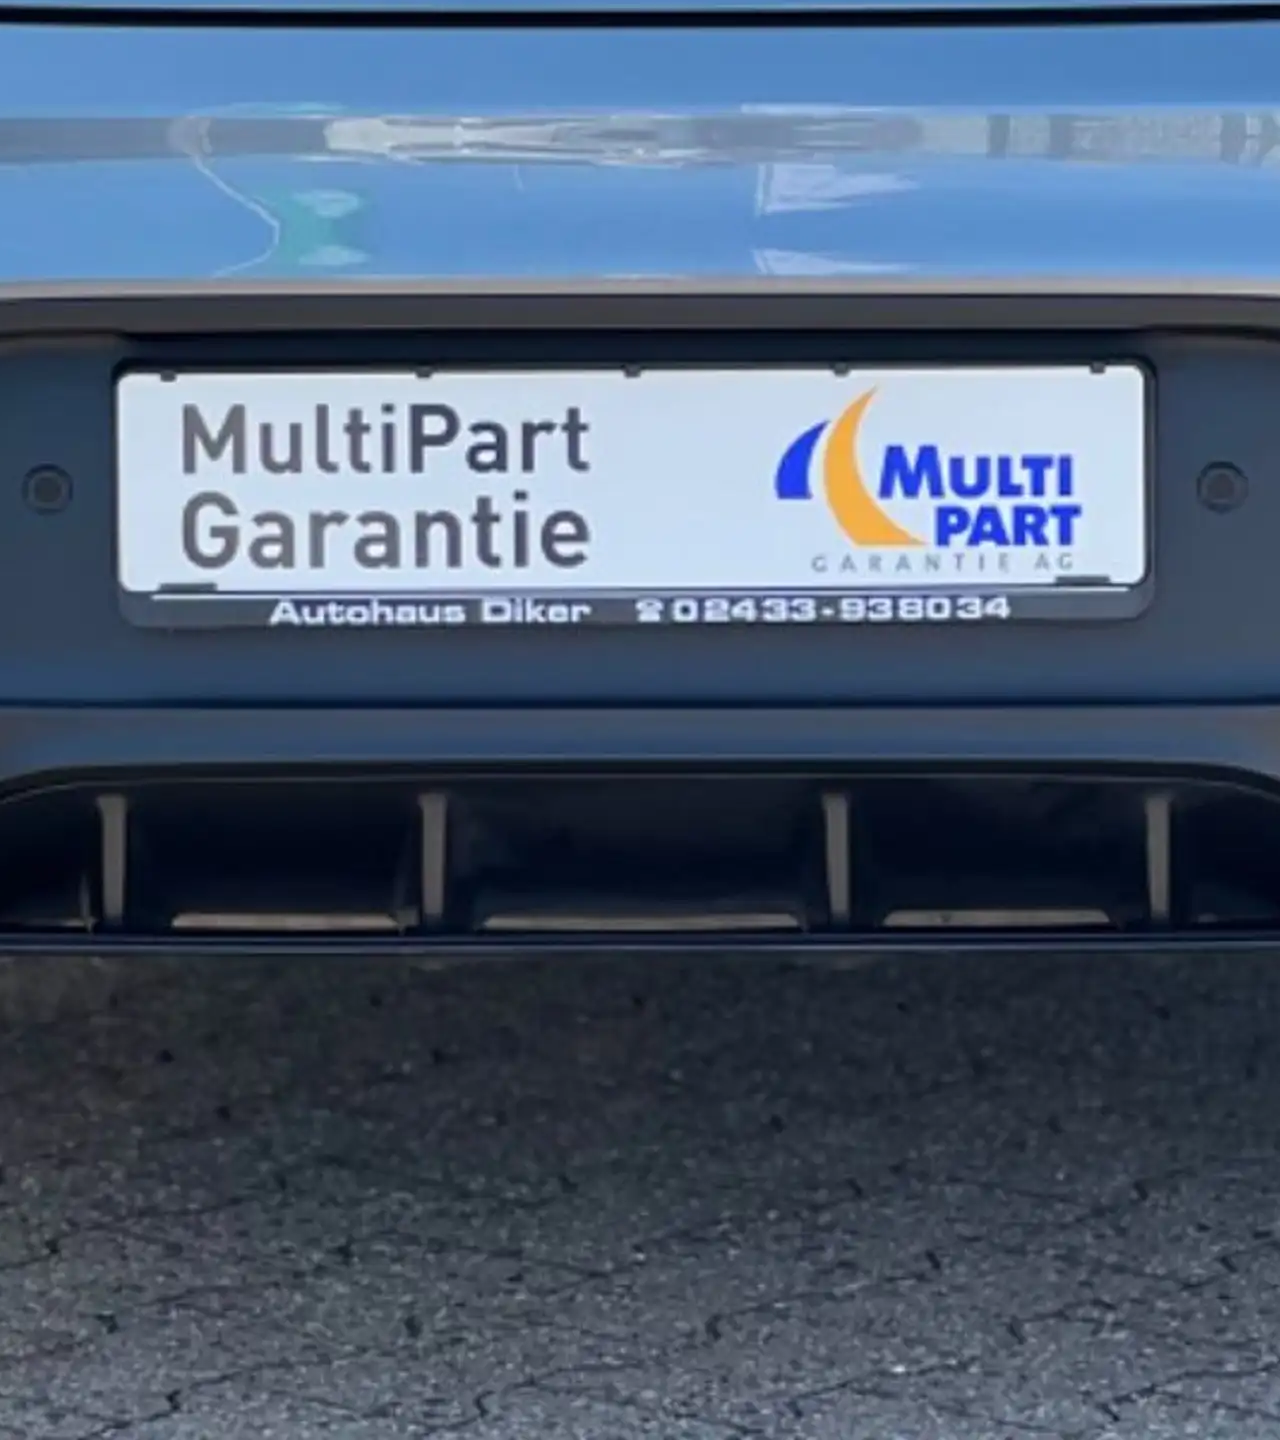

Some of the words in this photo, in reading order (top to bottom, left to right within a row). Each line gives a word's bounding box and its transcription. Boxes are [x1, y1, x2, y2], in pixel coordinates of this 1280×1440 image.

[182, 403, 591, 474] MultiPart
[879, 445, 1074, 500] MULTI
[182, 490, 591, 570] Garantie
[935, 505, 1082, 547] PART
[811, 554, 1010, 572] GARANTIE
[1033, 553, 1074, 571] AG
[269, 599, 467, 625] Autohaus
[481, 597, 592, 624] Diker
